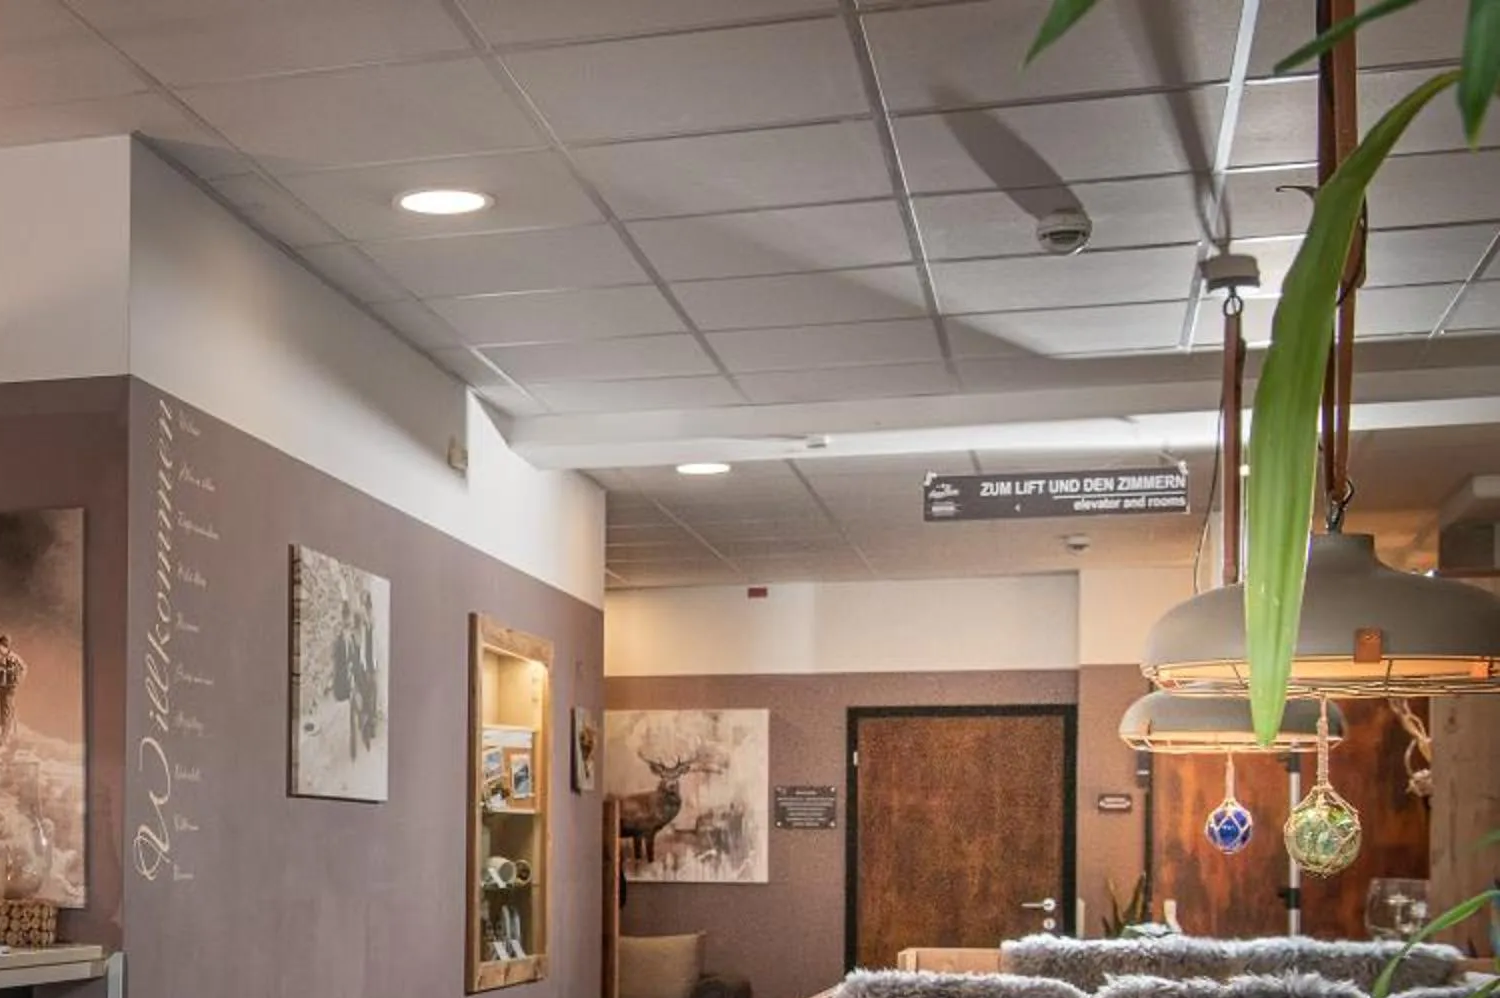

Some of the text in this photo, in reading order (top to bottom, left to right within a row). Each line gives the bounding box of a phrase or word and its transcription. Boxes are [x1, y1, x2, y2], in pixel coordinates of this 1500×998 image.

[980, 474, 1186, 497] ZUM LIFT UND DEN ZIMMERN
[1124, 496, 1145, 509] and
[1148, 496, 1186, 508] rooms
[133, 399, 174, 881] Willkommen
